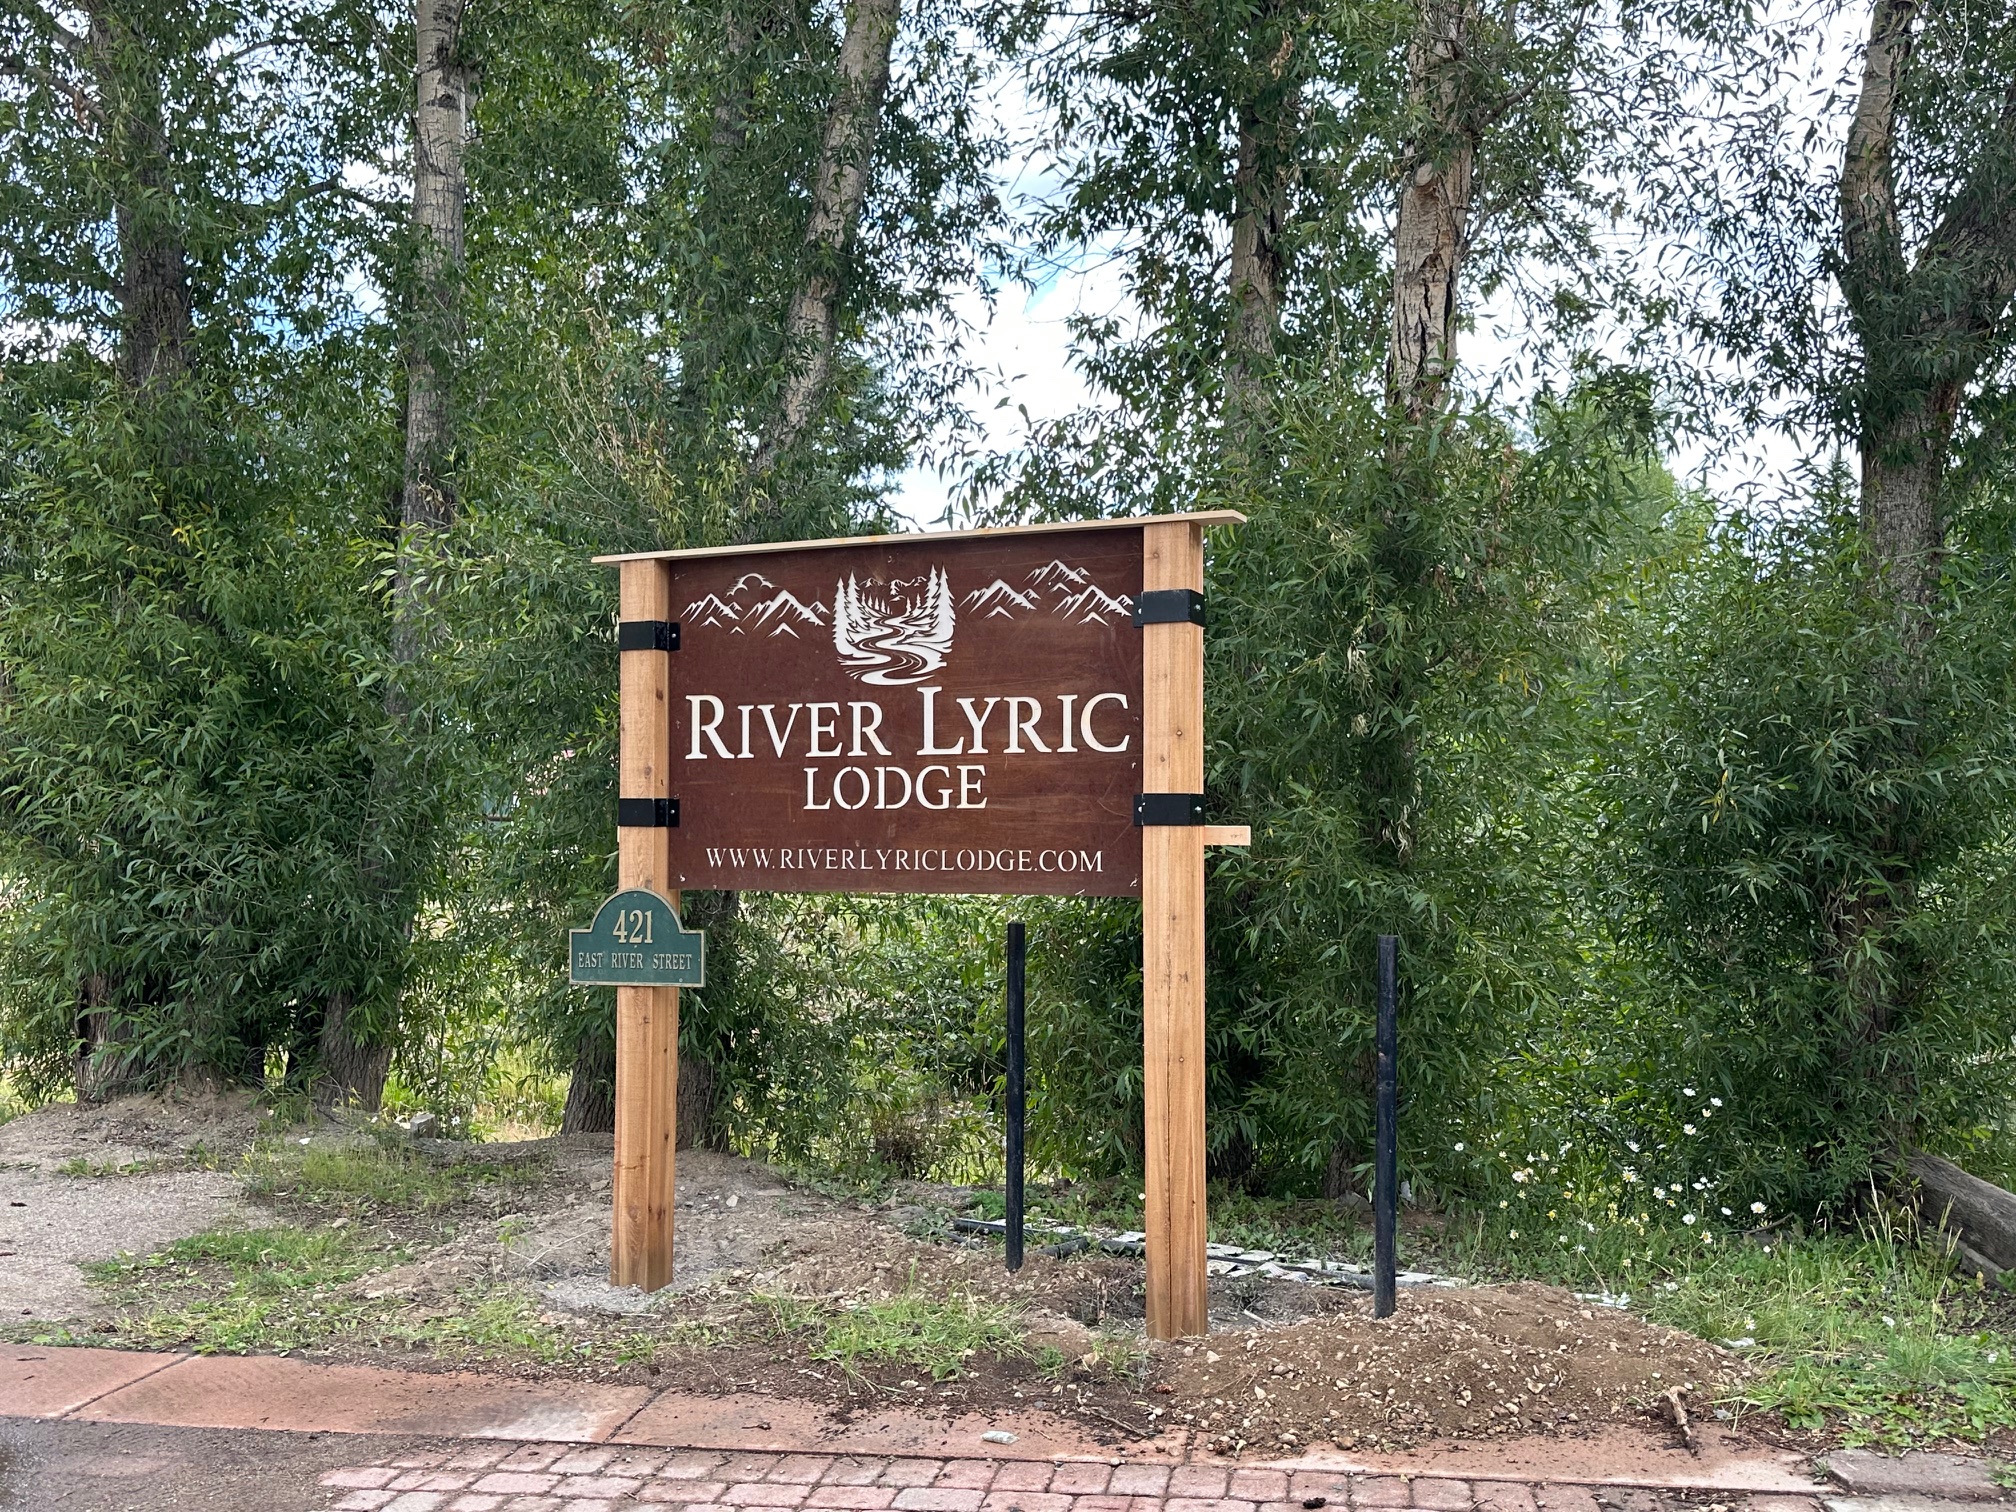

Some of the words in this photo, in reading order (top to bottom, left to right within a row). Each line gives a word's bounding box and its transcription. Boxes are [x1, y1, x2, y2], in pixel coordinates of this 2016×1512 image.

[685, 694, 892, 760] RIVER
[916, 686, 1130, 757] LYRIC
[803, 764, 988, 811] LODGE
[705, 847, 1104, 873] WWW.RIVERLYRICLODGE.COM
[612, 909, 653, 944] 421
[578, 952, 604, 968] EAST
[611, 952, 644, 969] RIVER
[652, 953, 693, 970] STREET
